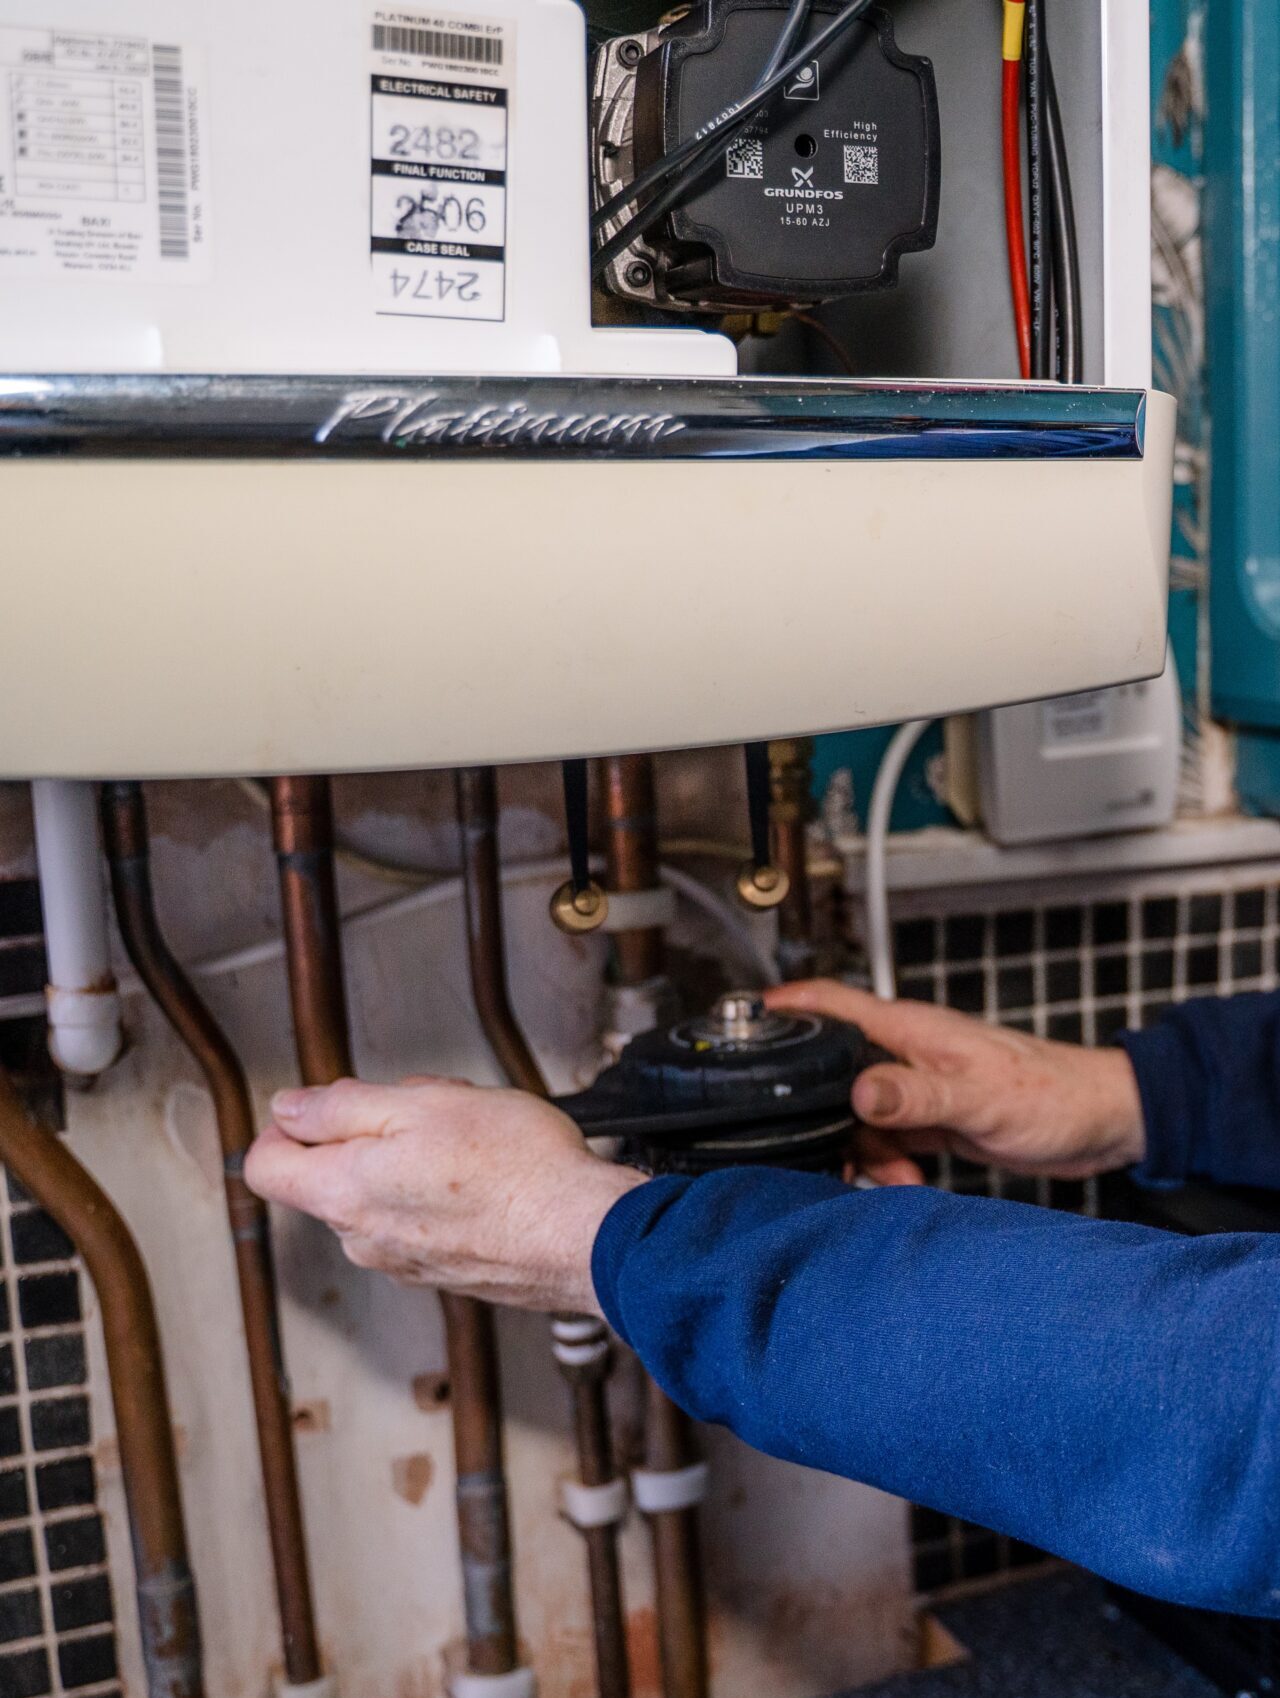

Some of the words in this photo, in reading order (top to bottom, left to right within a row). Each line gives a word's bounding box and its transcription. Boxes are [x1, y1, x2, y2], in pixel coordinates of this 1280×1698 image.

[374, 11, 431, 25] PLATINUM
[447, 20, 483, 32] COMBI
[380, 79, 452, 99] ELECTRICAL
[453, 87, 497, 102] SAFETY
[823, 129, 878, 142] Efficiency
[853, 121, 878, 132] High
[389, 124, 480, 160] 2482
[393, 162, 427, 178] FINAL
[429, 166, 486, 182] FUNCTION
[764, 188, 844, 200] GRUNDFOS
[395, 189, 486, 233] 2506
[786, 203, 823, 214] UPM3
[780, 217, 807, 226] 15-60
[812, 218, 830, 227] AZJ
[406, 241, 438, 255] CASE
[440, 244, 470, 257] SEAL
[389, 268, 481, 302] 2474
[315, 388, 686, 444] Platinum
